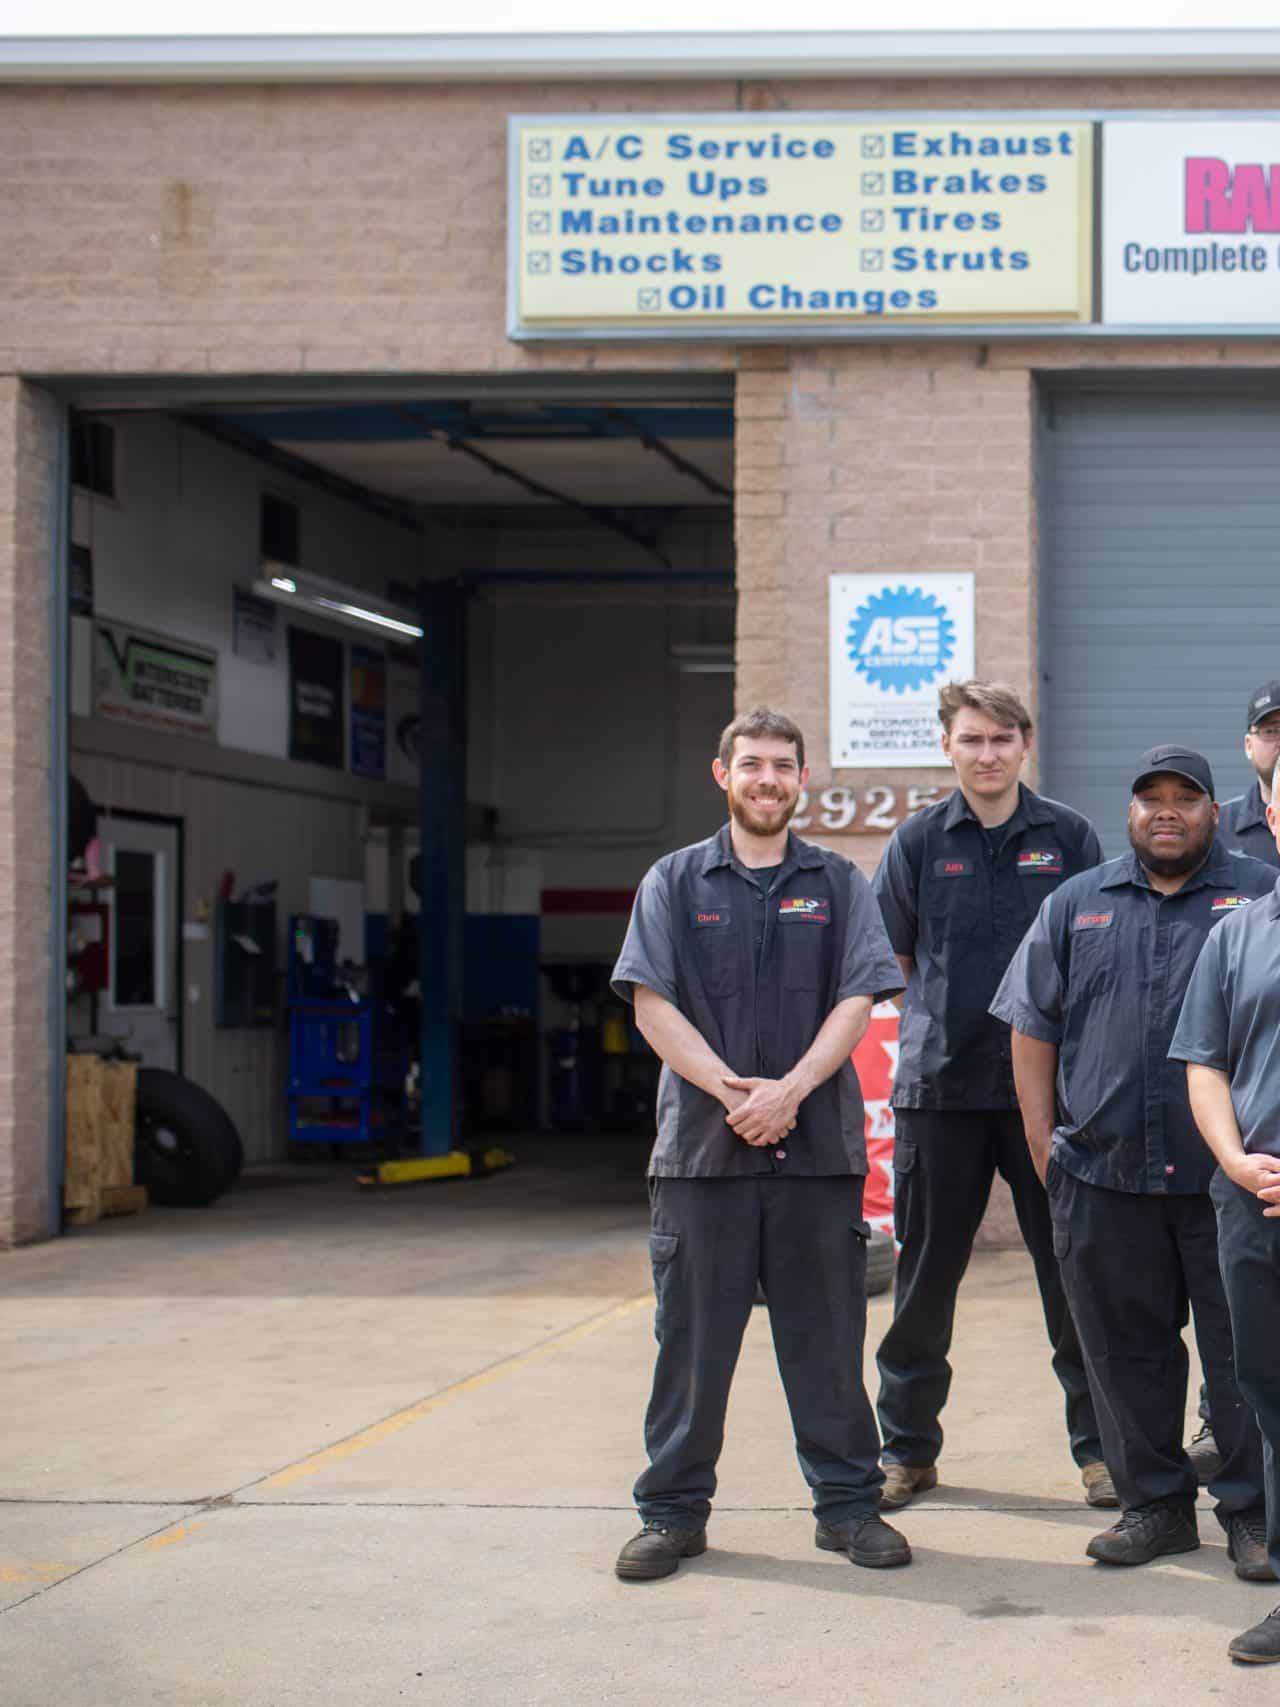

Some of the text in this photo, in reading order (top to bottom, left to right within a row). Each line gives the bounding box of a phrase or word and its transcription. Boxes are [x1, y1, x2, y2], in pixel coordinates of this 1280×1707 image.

[563, 134, 836, 161] A/C Service
[892, 131, 1073, 157] Exhaust
[563, 171, 768, 200] Tune Ups
[892, 168, 1048, 194] Brakes
[560, 209, 843, 235] Maintenance
[893, 206, 1002, 231] Tires
[560, 248, 722, 274] Shocks
[892, 246, 1030, 272] Struts
[1123, 242, 1267, 275] Complete
[668, 283, 938, 313] Oil Changes
[858, 617, 940, 655] ASE
